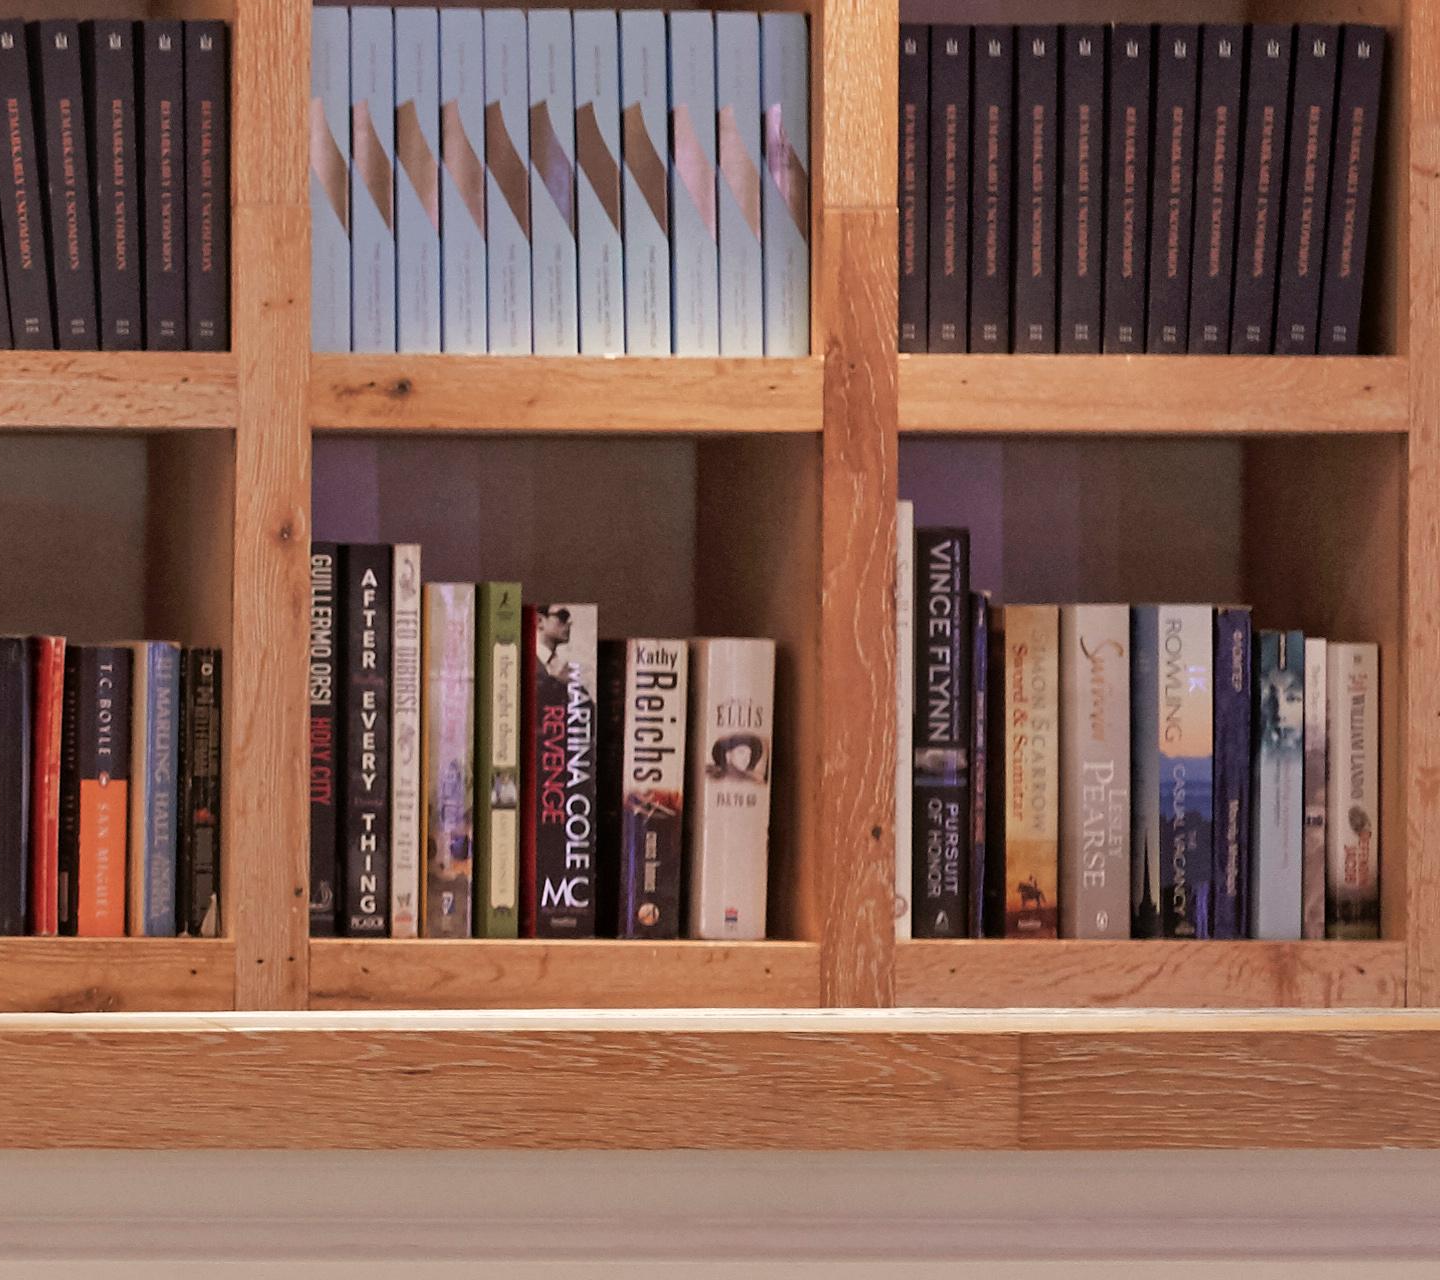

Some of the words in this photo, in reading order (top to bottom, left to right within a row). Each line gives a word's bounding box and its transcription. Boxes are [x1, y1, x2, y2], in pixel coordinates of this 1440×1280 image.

[311, 554, 332, 660] GUILLERMO
[360, 569, 377, 669] AFTER
[928, 540, 952, 637] VINCE
[311, 663, 332, 706] ORSI
[636, 646, 679, 669] Kathy
[928, 647, 951, 742] FLYNN
[1012, 643, 1028, 704] Sword
[1031, 631, 1047, 709] SIMON
[1163, 618, 1183, 744] ROWLING
[98, 698, 113, 756] BOYLE
[155, 688, 171, 784] MARLING
[310, 717, 331, 760] HOLY
[360, 690, 377, 791] EVERY
[566, 661, 592, 787] MARTINA
[633, 671, 678, 783] Reichs
[716, 705, 764, 729] ELLIS
[1013, 708, 1028, 727] &
[1350, 694, 1365, 751] WILLIAM
[310, 767, 331, 806] CITY
[541, 705, 565, 826] REVENGE
[1011, 734, 1028, 822] Scimitar
[1030, 720, 1050, 832] SCARROW
[96, 803, 109, 837] SAN
[154, 792, 171, 847] HALL
[566, 794, 592, 869] COLE
[927, 798, 942, 822] OF
[1082, 759, 1114, 889] PEARSE
[1107, 786, 1127, 859] LESLEY
[95, 848, 109, 919] MIGUEL
[360, 813, 377, 913] THING
[927, 831, 942, 898] HONOR
[942, 802, 960, 895] PURSUIT
[541, 877, 589, 909] MC
